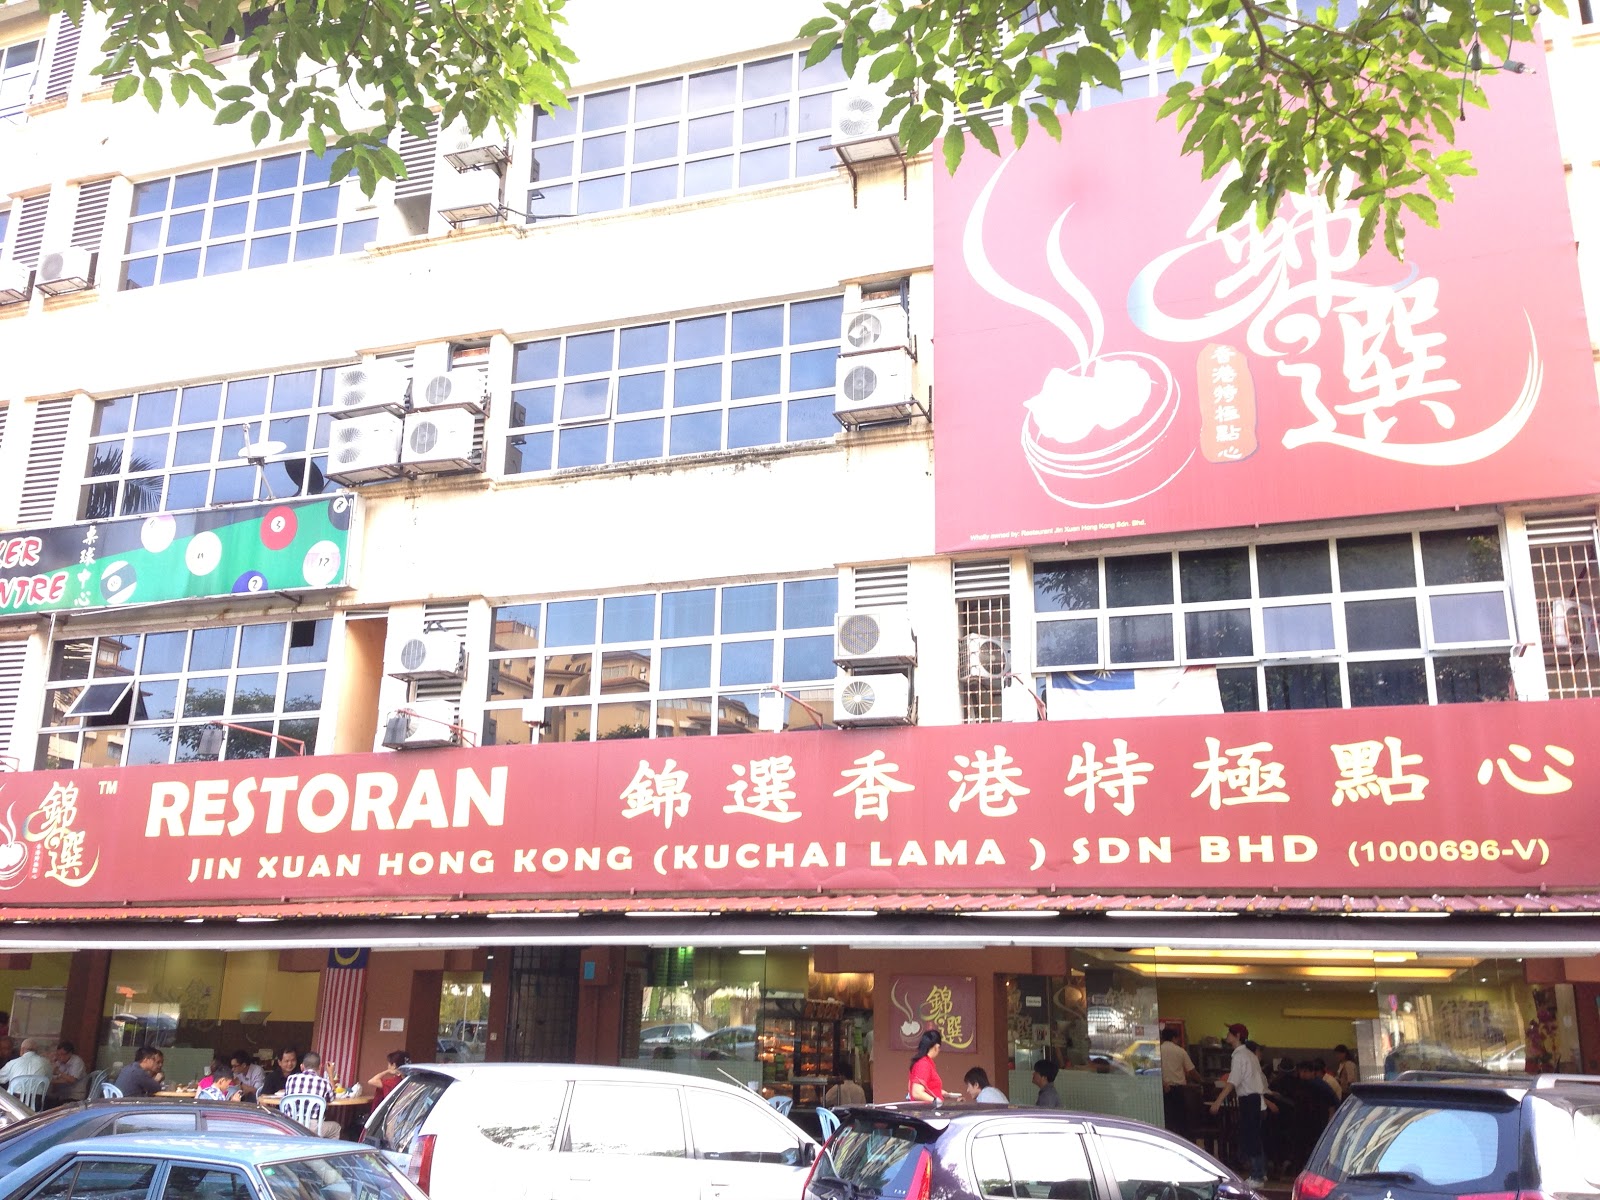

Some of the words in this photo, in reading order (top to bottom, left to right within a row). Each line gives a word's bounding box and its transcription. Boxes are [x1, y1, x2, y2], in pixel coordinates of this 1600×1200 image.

[1210, 344, 1243, 459] 香港特極點心
[74, 525, 99, 606] 桌球中心
[98, 780, 118, 795] TM
[144, 766, 509, 838] RESTORAN
[620, 736, 1575, 830] 錦選香港特極點心
[187, 855, 242, 883] JIN
[256, 853, 361, 879] XUAN
[378, 849, 495, 877] HONG
[513, 845, 633, 874] KONG
[652, 840, 848, 876] (KUCHAI
[870, 839, 1006, 867] LAMA
[1072, 836, 1172, 865] SDN
[1199, 835, 1319, 864] BHD
[1348, 837, 1551, 868] (1000696-V)
